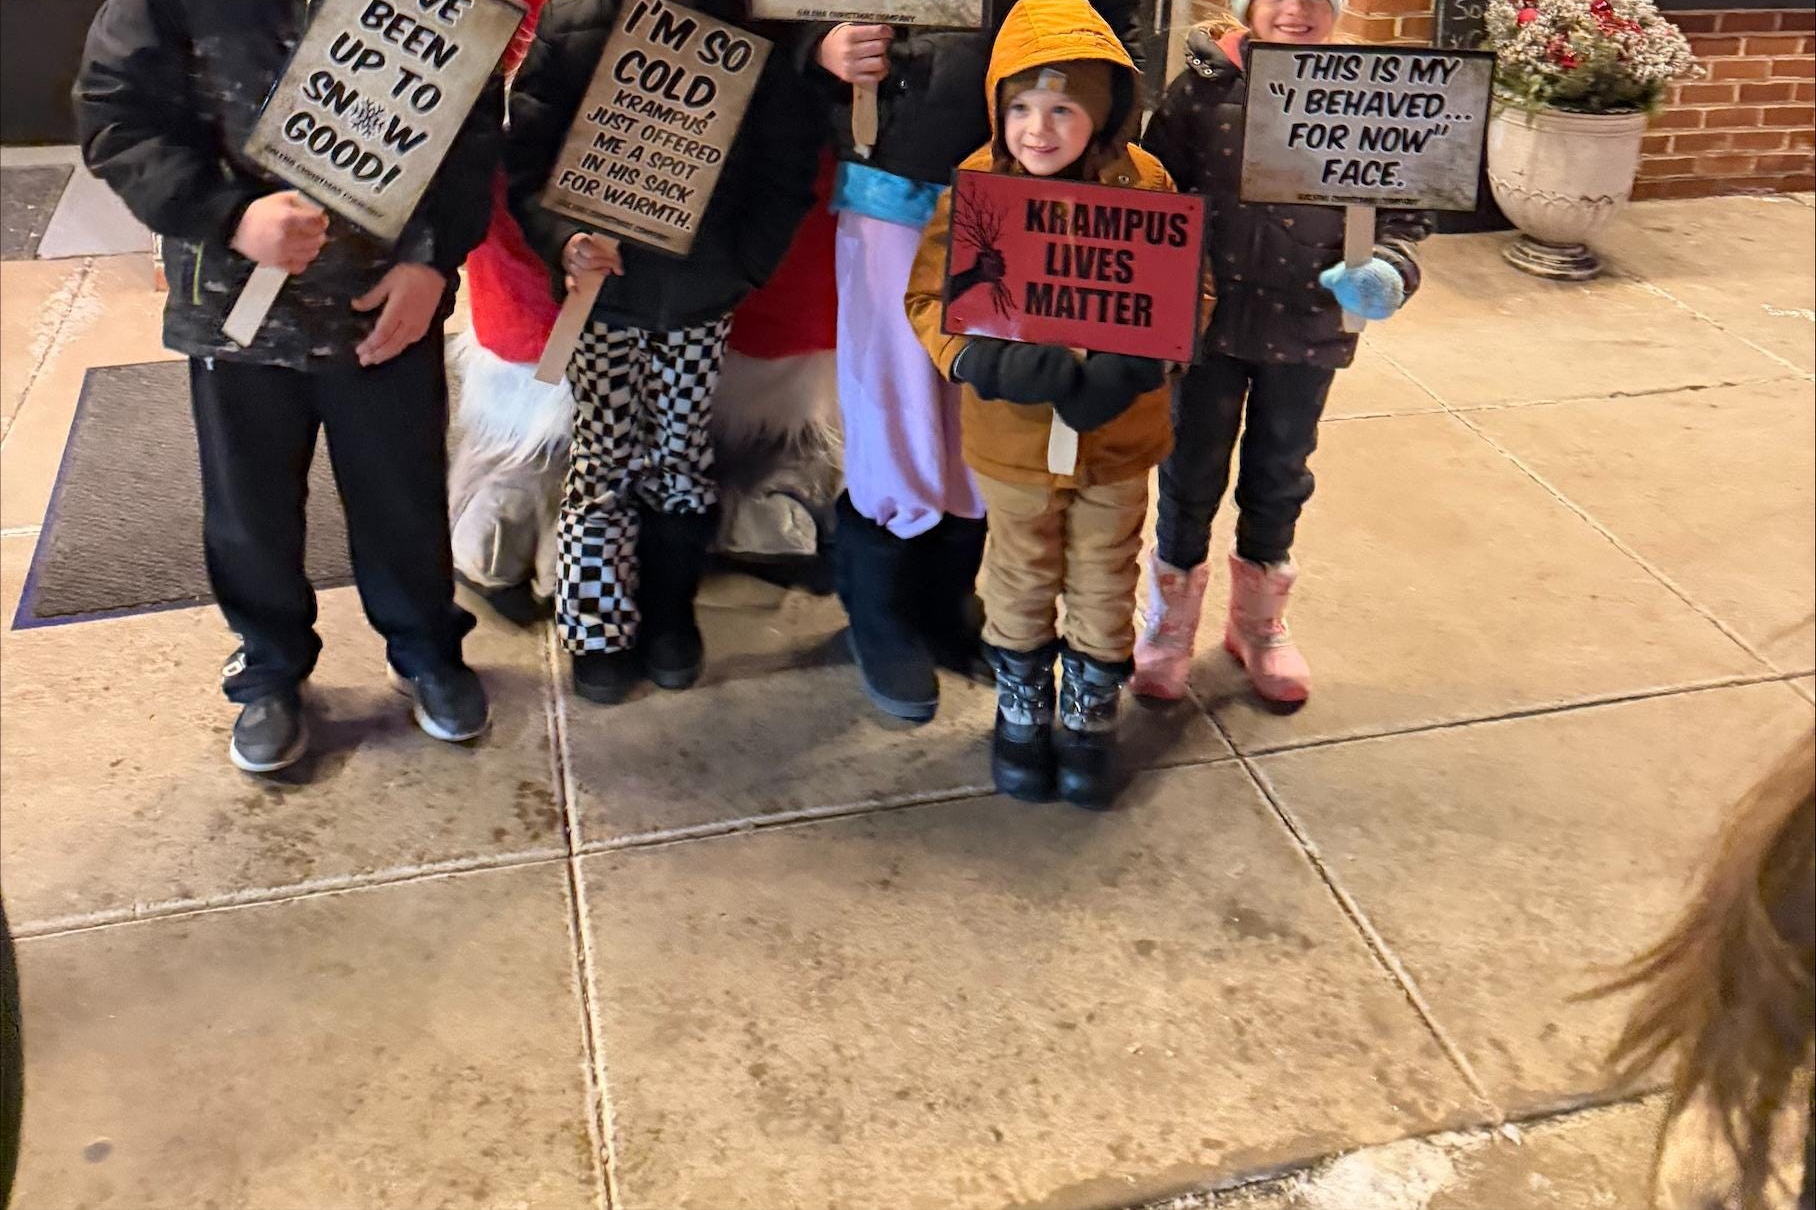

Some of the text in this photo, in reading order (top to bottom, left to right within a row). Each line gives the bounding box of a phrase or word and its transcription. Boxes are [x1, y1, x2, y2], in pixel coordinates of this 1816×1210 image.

[361, 0, 459, 69] BEEN
[624, 0, 752, 73] I'M SO
[330, 32, 442, 113] UP TO
[1294, 53, 1461, 85] THIS IS MY
[613, 90, 708, 135] KRAMPUS
[1304, 89, 1473, 121] BEHAVED...
[284, 112, 402, 193] GOOD!
[587, 106, 722, 164] JUST OFFERED
[593, 132, 699, 180] ME A SPOT
[1288, 123, 1449, 153] FOR NOW"
[581, 153, 694, 205] IN HIS SACK
[1321, 159, 1405, 188] FACE.
[558, 171, 601, 198] FOR
[602, 185, 693, 231] WARMTH.
[1024, 198, 1189, 248] KRAMPUS
[1045, 242, 1135, 285] LIVES
[1024, 281, 1154, 328] MATTER
